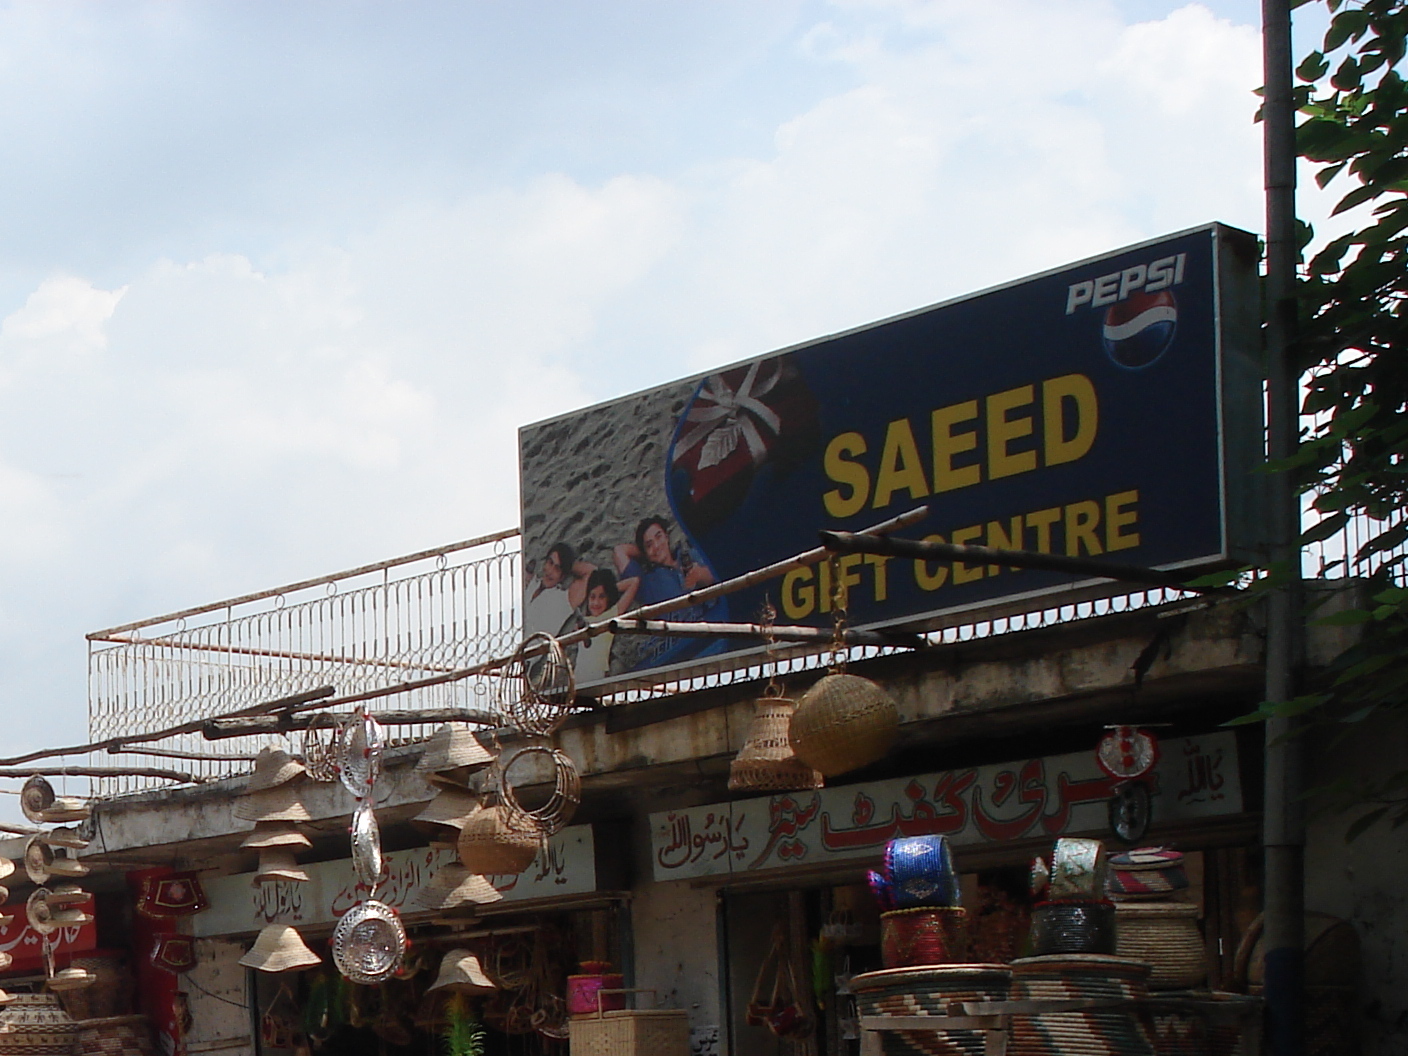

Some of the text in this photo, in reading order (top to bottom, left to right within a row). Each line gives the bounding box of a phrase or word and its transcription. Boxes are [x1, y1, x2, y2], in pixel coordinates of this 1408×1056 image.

[1065, 252, 1187, 316] PEPSI
[822, 372, 1099, 519] SAEED
[780, 488, 1141, 621] GIFT CENTRE
[821, 767, 978, 853] گفٹ
